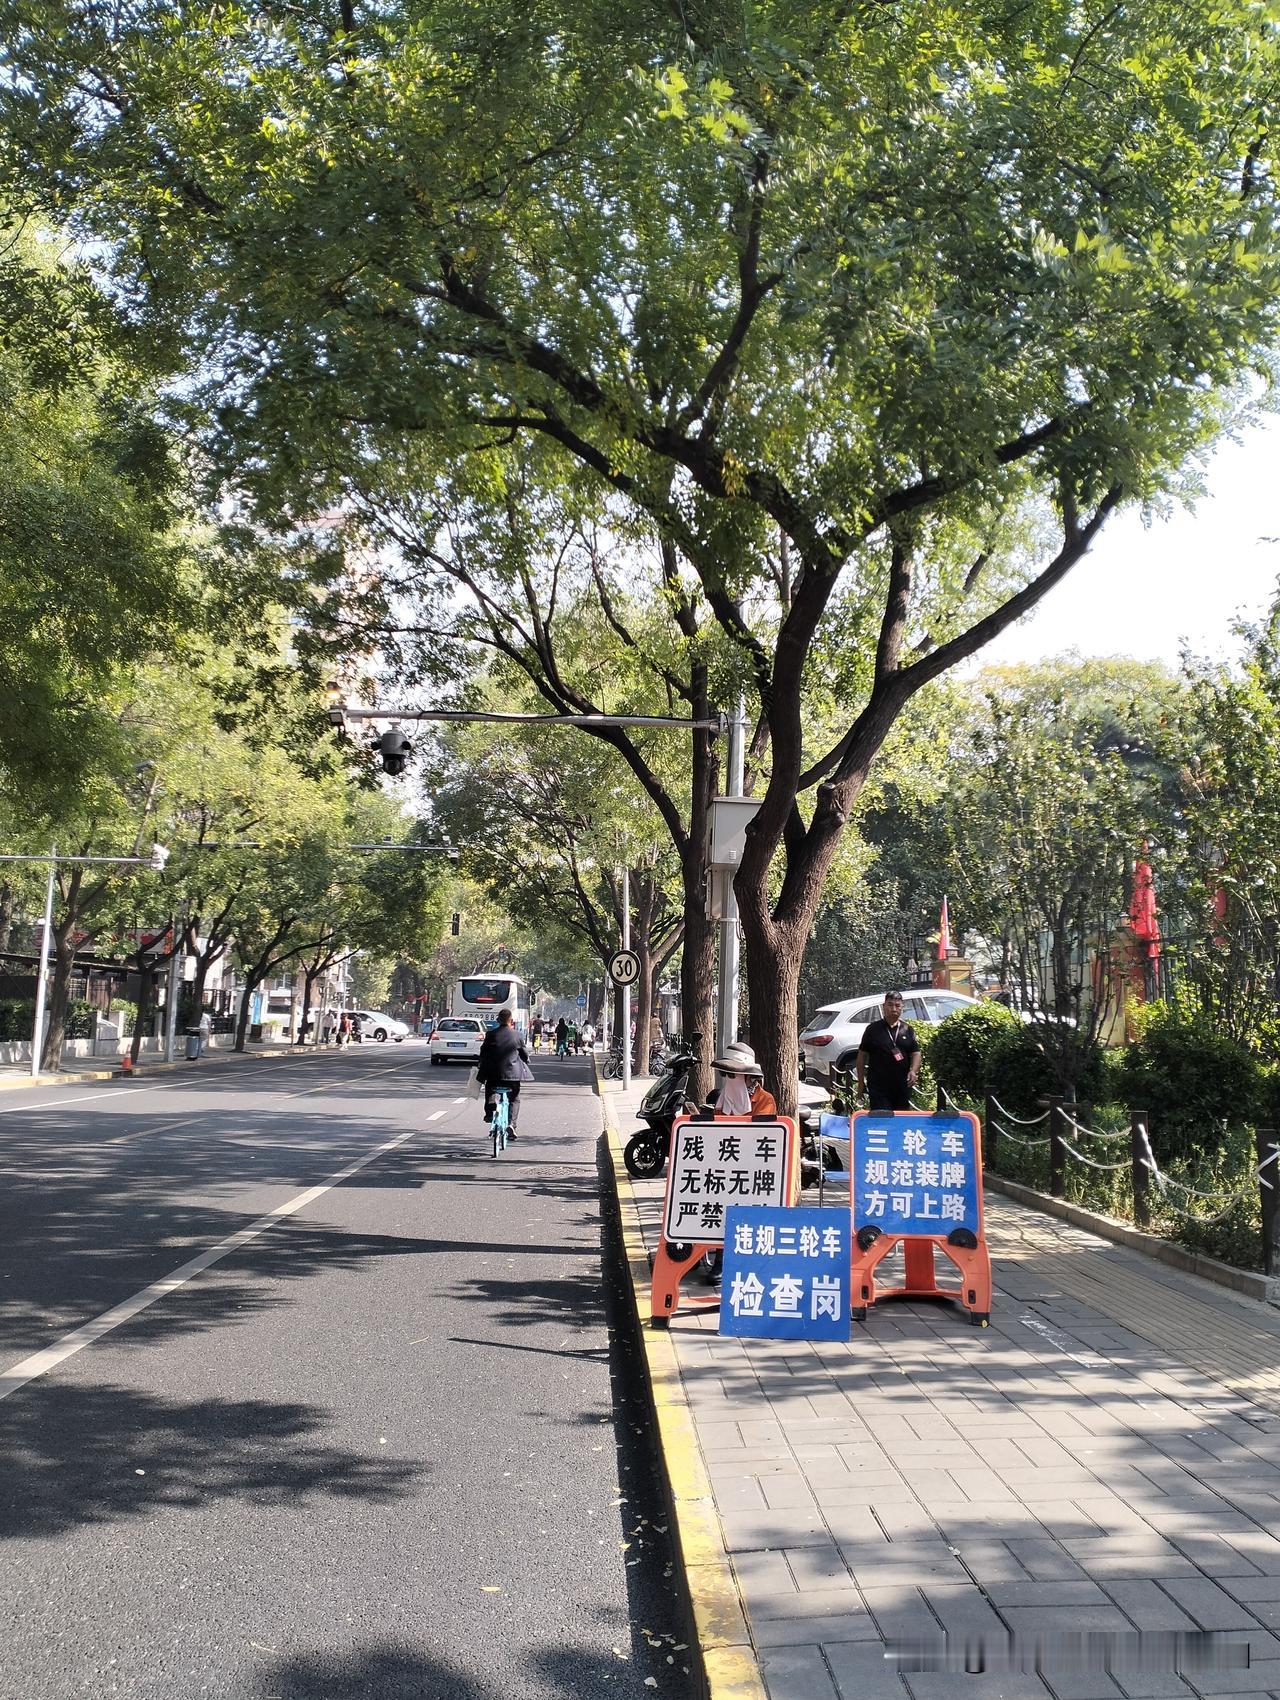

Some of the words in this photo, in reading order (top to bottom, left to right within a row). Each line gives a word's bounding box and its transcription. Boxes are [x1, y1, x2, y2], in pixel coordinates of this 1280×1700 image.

[615, 960, 632, 977] 30
[682, 1135, 777, 1162] 残疾车
[865, 1130, 965, 1157] 三轮车
[679, 1168, 776, 1196] 无标无牌
[864, 1159, 966, 1189] 规范装牌
[864, 1191, 966, 1222] 方可上路
[734, 1225, 841, 1258] 违规三轮车
[730, 1271, 841, 1321] 检查岗
